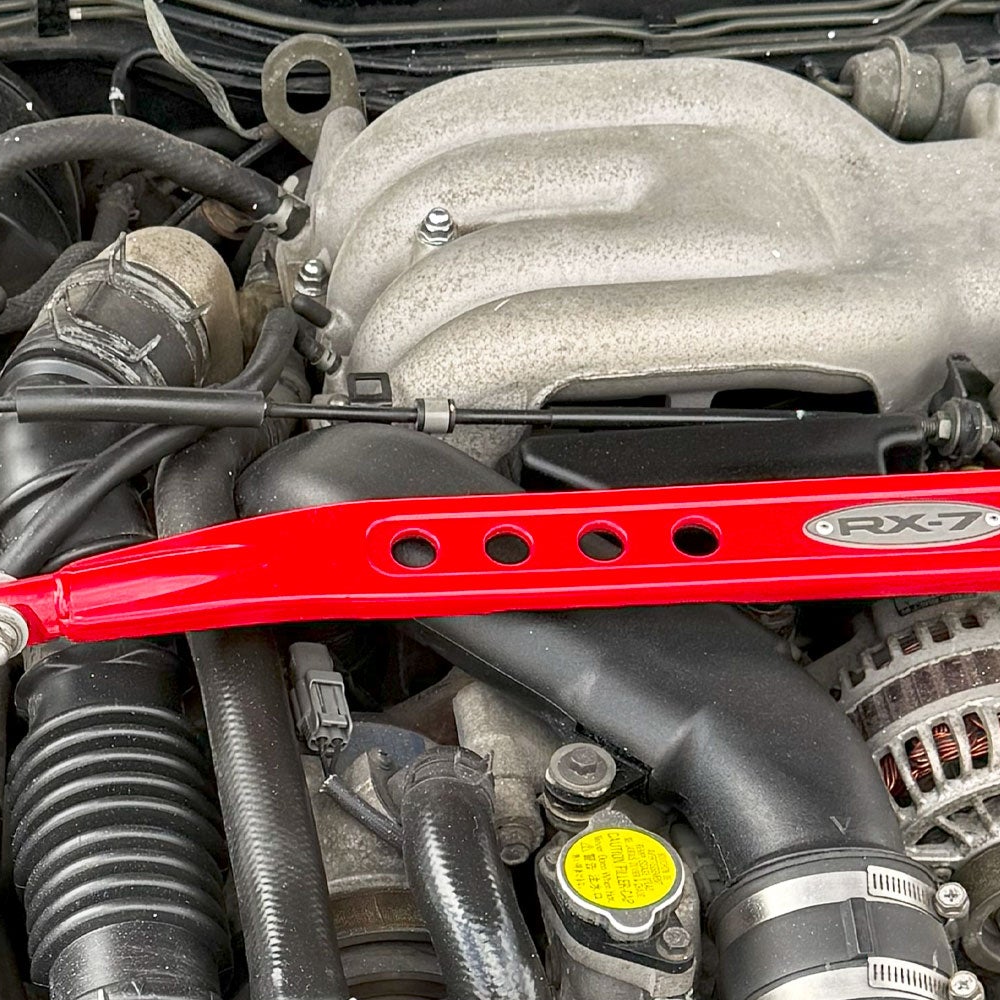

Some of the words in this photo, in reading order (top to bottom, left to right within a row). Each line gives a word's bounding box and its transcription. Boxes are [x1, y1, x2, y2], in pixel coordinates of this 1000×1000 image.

[838, 511, 983, 536] RX-7
[606, 831, 624, 864] CAUTION
[615, 863, 631, 889] FILLER
